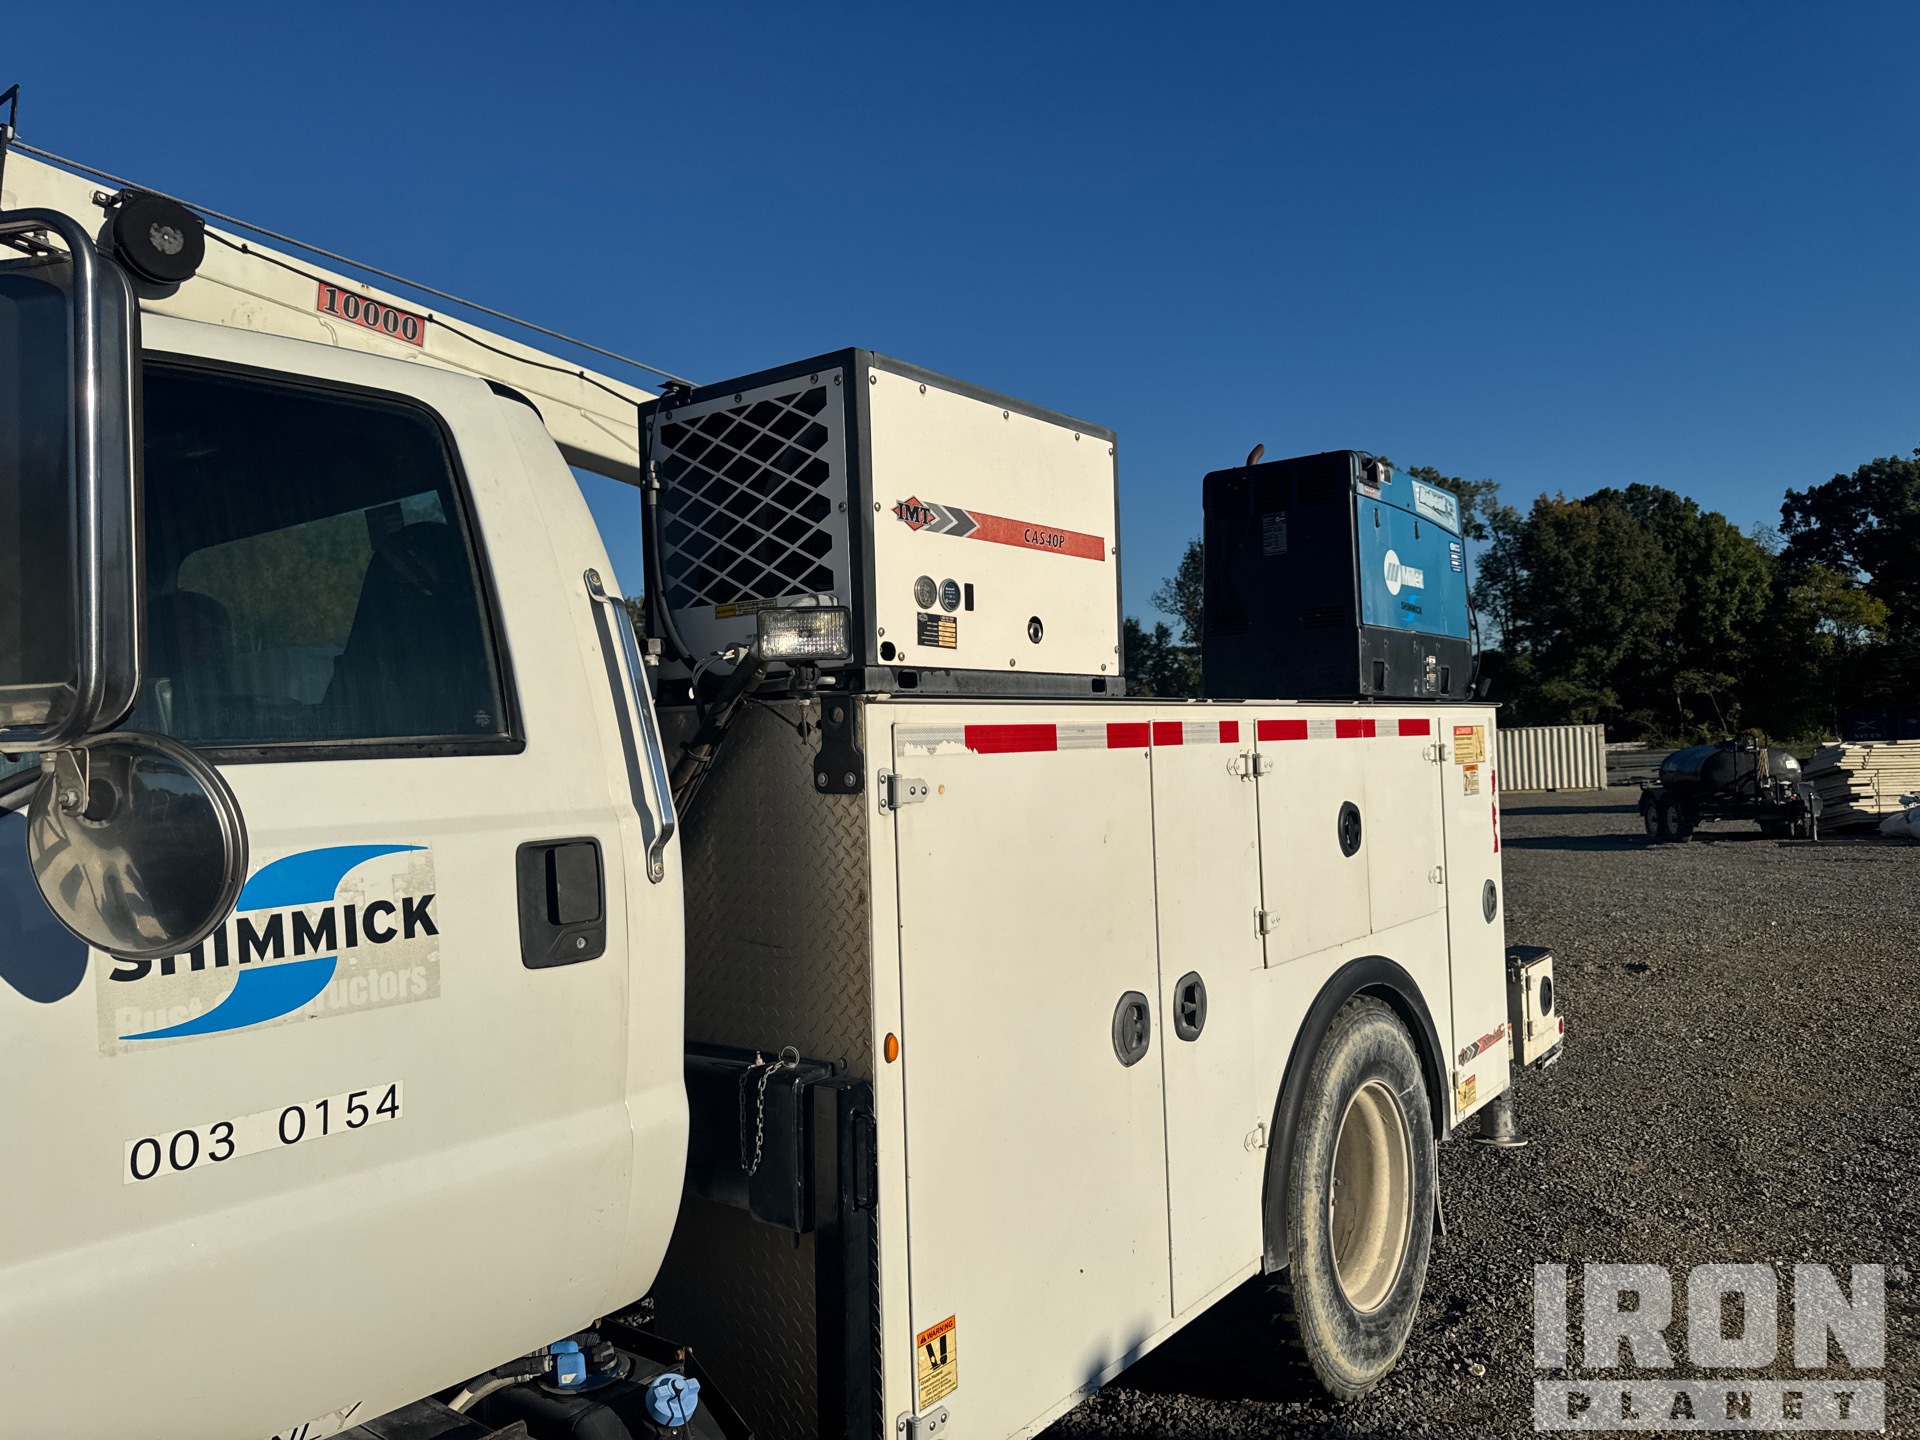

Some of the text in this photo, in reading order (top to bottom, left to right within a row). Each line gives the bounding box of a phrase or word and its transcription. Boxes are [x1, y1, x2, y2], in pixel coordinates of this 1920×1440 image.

[324, 288, 418, 341] 10000
[898, 502, 931, 525] IMT
[1024, 529, 1065, 549] CAS40P
[130, 1084, 400, 1181] 003 0154
[926, 1320, 953, 1339] WARNING
